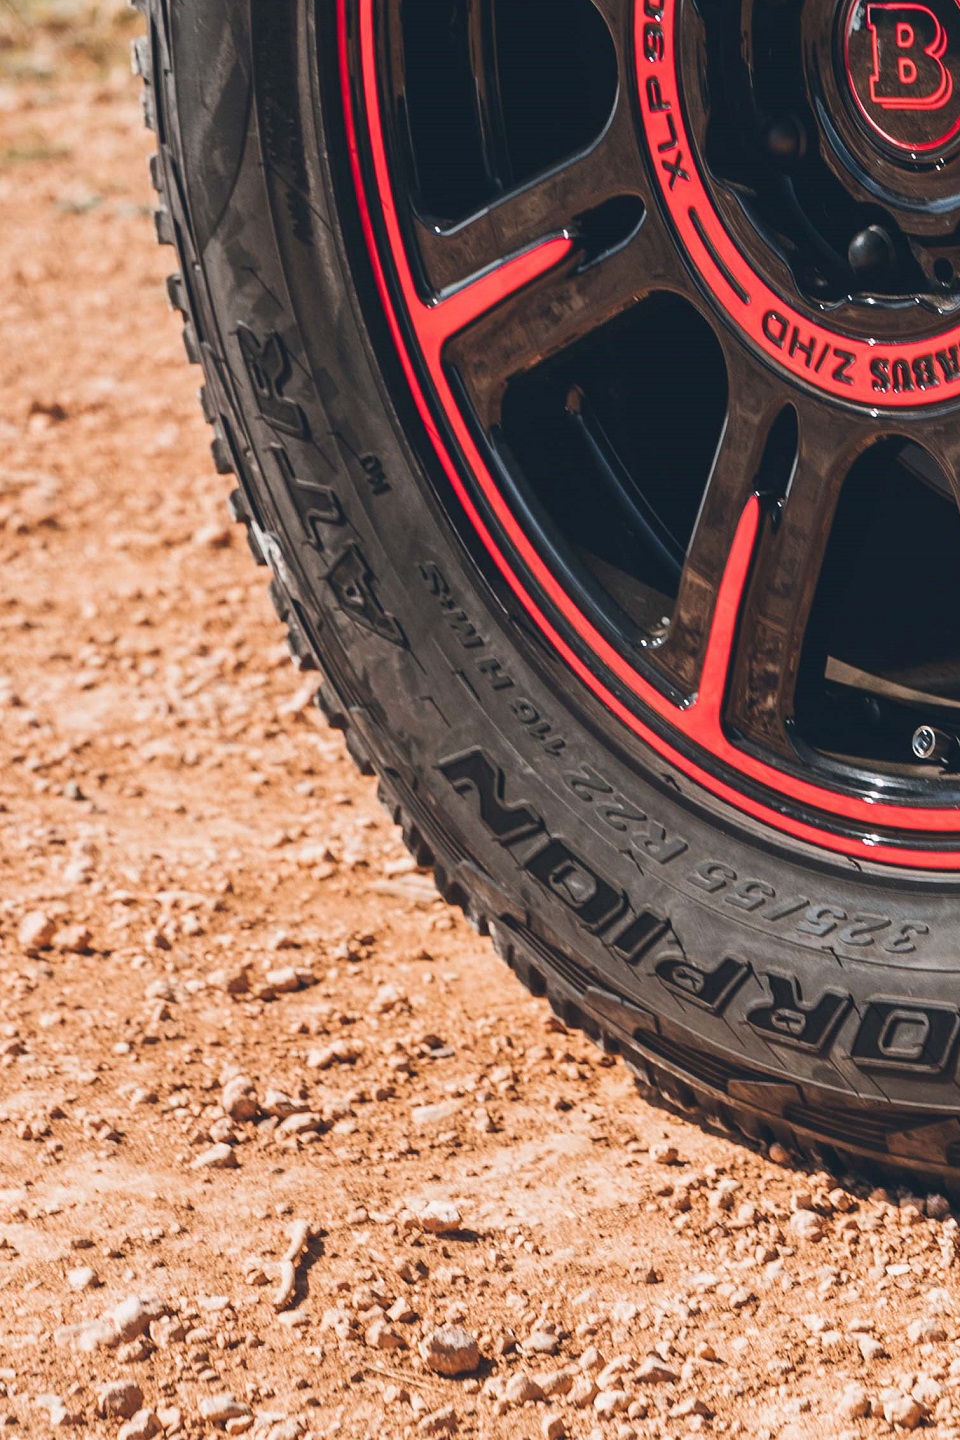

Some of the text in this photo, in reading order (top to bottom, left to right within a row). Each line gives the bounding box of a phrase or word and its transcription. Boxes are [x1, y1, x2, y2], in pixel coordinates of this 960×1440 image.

[866, 3, 953, 109] B
[645, 76, 693, 192] XLP
[761, 311, 853, 384] Z/HD
[230, 322, 411, 650] ATR
[418, 561, 486, 652] M+S
[686, 858, 931, 954] 325/55
